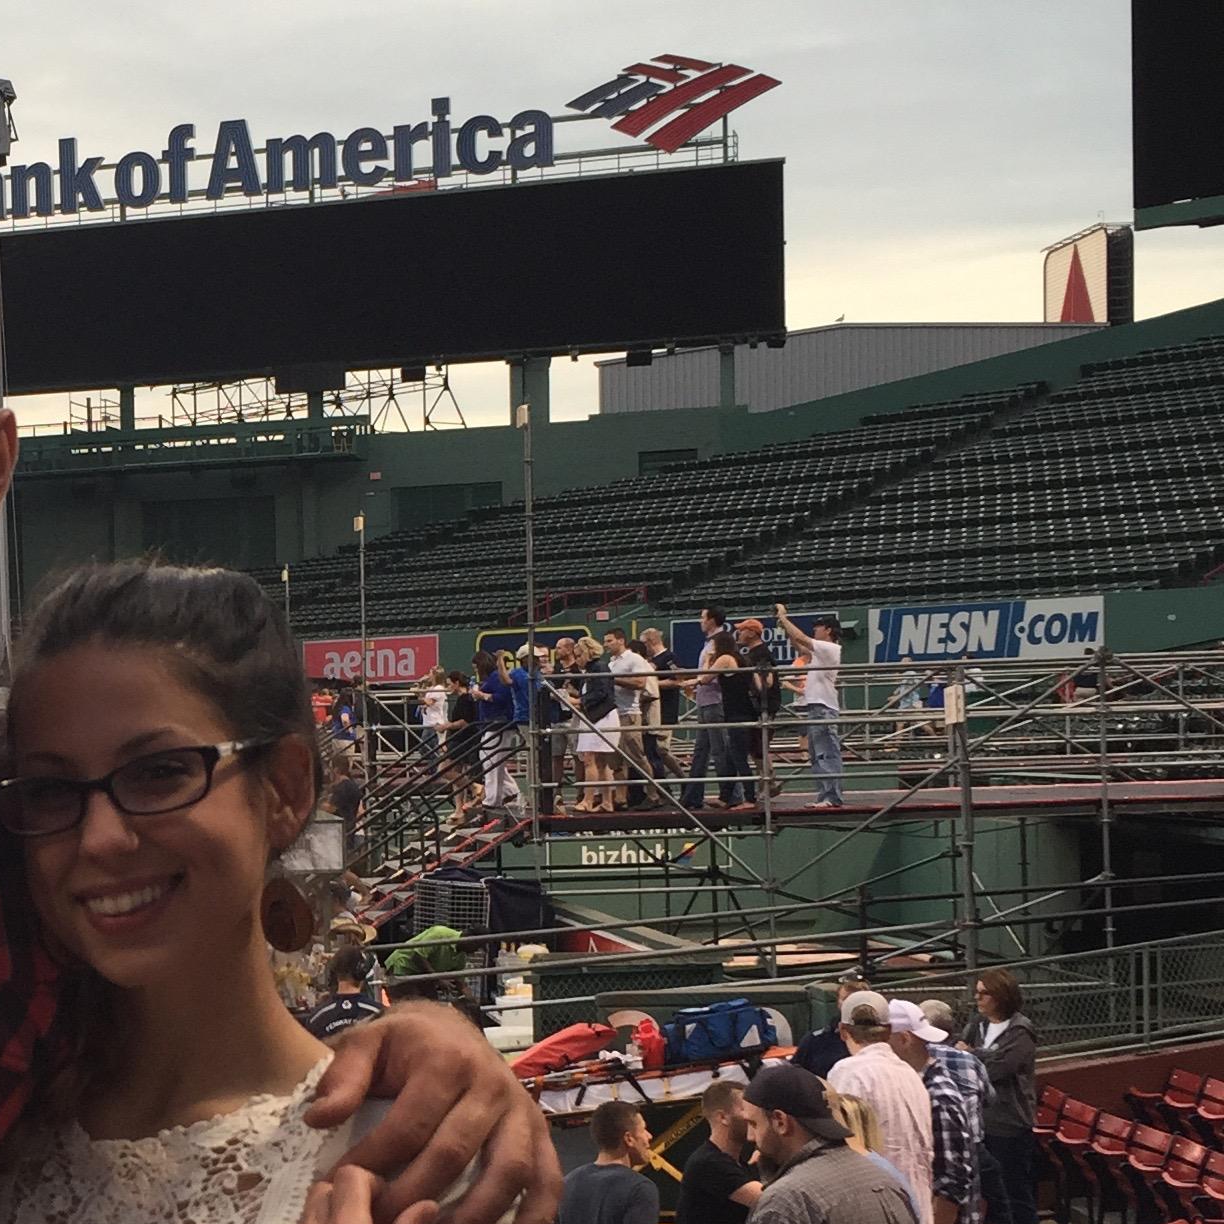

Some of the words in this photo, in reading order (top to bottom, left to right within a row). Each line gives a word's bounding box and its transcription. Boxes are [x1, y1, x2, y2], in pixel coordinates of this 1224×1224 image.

[114, 123, 196, 209] of
[206, 96, 554, 201] America
[898, 609, 1000, 655] NESN
[323, 646, 415, 680] aetna
[581, 842, 672, 866] bizhub
